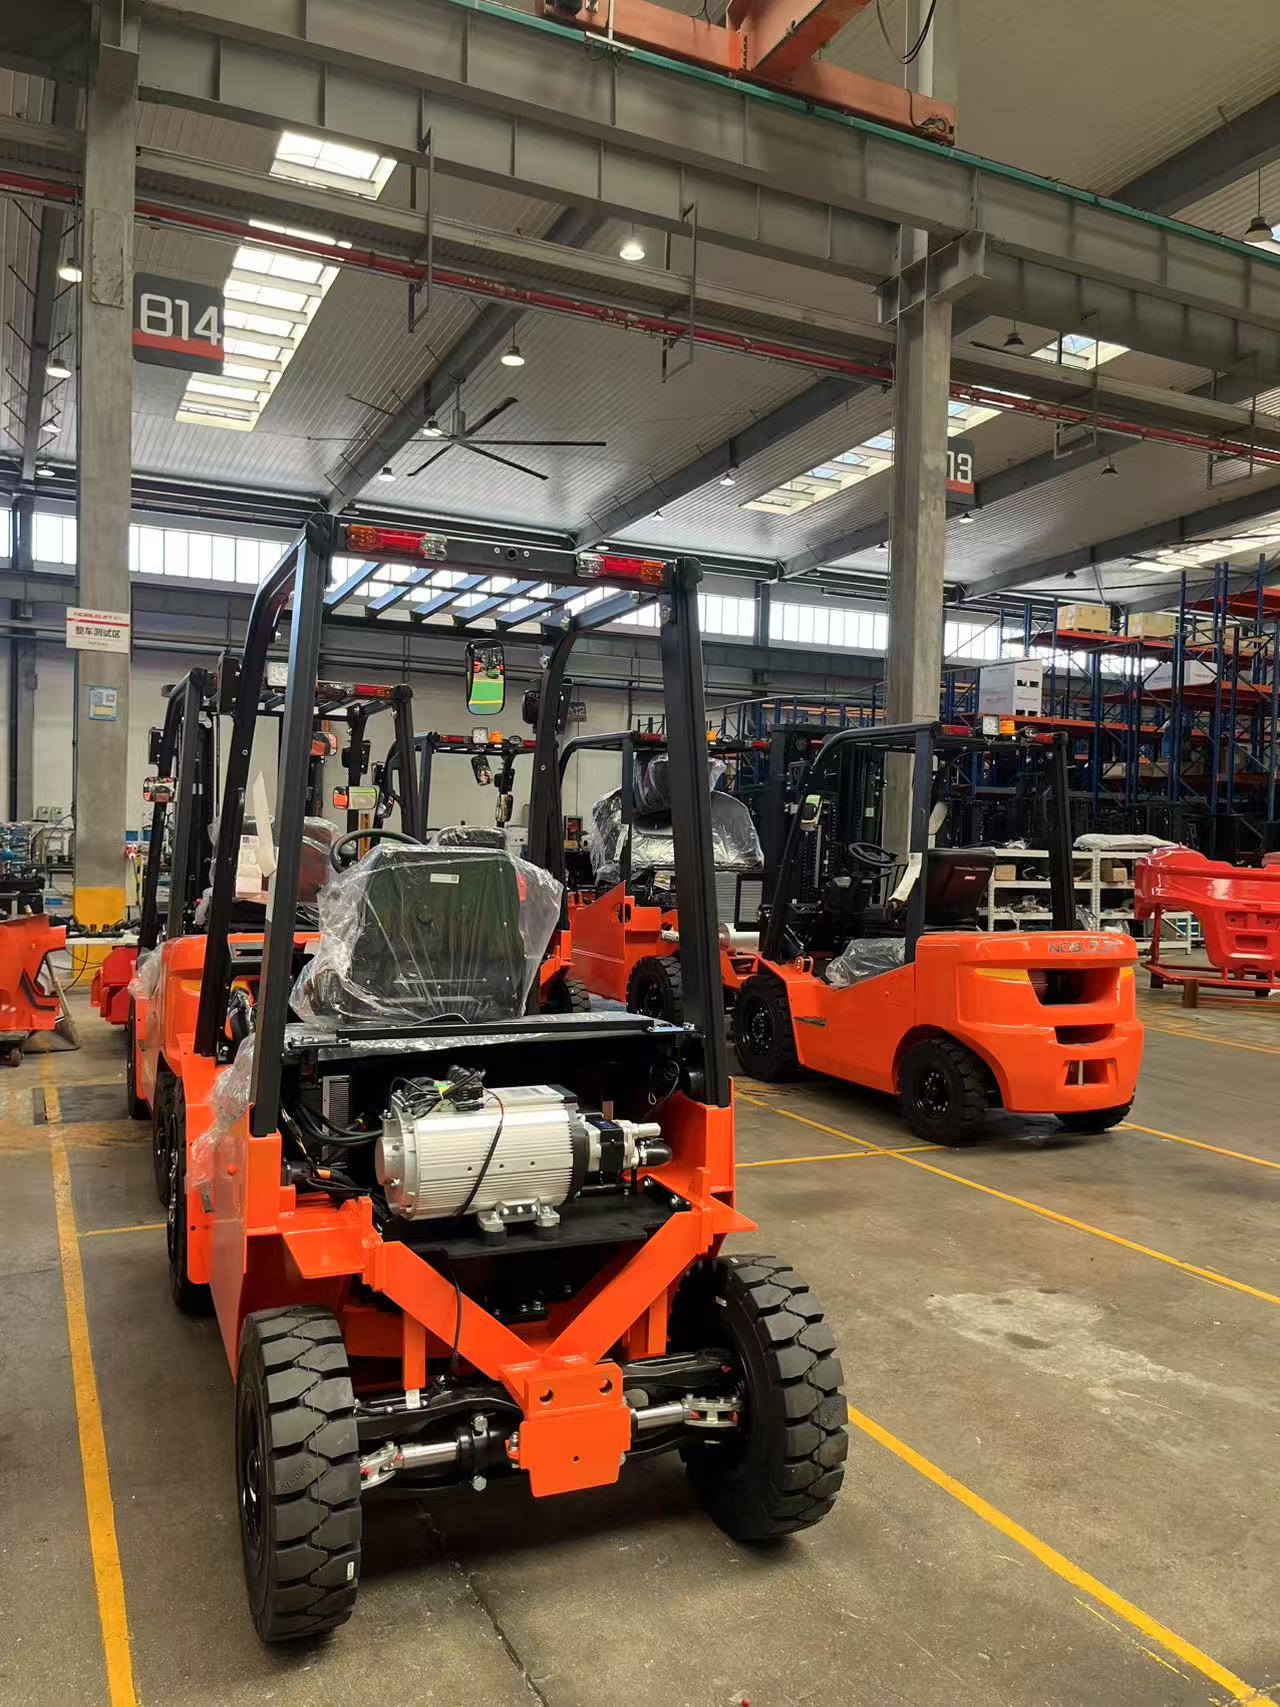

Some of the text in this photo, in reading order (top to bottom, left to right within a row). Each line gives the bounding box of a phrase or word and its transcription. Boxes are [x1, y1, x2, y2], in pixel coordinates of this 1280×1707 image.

[140, 293, 222, 346] B14
[946, 450, 973, 484] 13
[75, 625, 121, 639] 整车测试区
